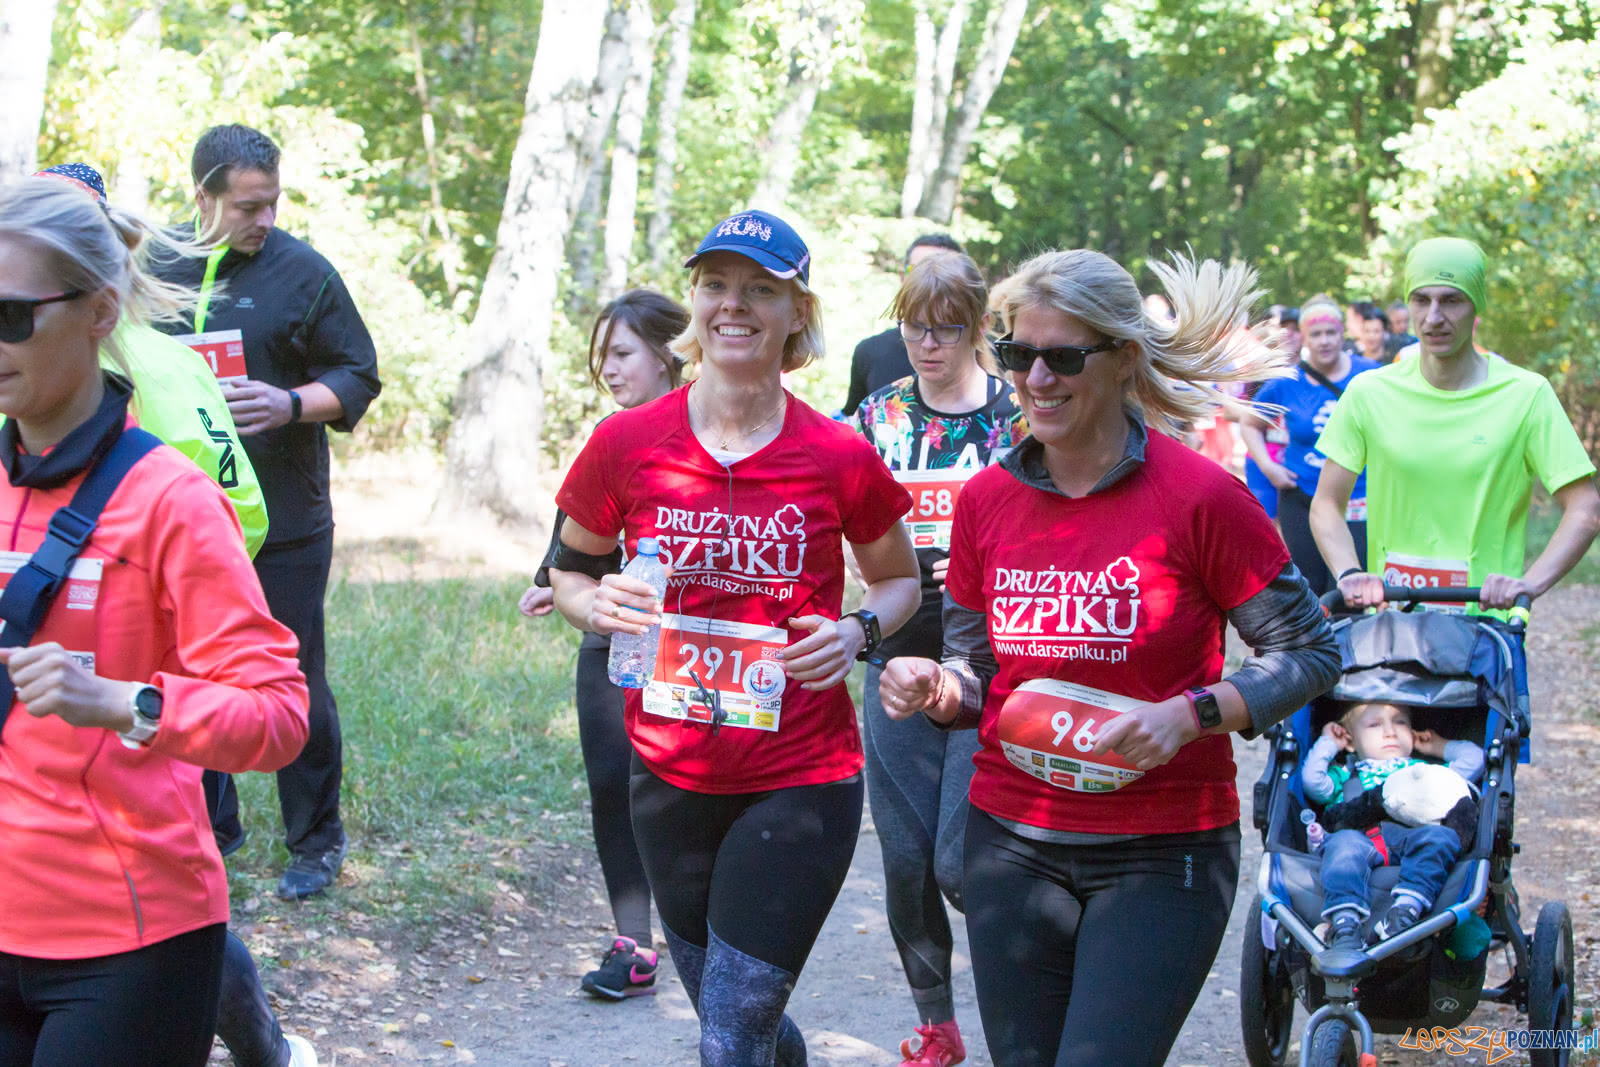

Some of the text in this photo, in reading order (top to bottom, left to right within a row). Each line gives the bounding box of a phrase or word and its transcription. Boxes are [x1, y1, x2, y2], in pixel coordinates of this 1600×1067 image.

[716, 215, 772, 242] RUN
[655, 506, 781, 540] DRUŻYNA
[655, 534, 807, 577] SZPIKU
[667, 574, 793, 601] ww.darszpiku.pl
[993, 564, 1111, 595] DRUŻYNA
[992, 594, 1141, 636] SZPIKU
[675, 643, 743, 684] 291
[994, 640, 1127, 664] www.darszpiku.pl
[1051, 711, 1096, 752] 96
